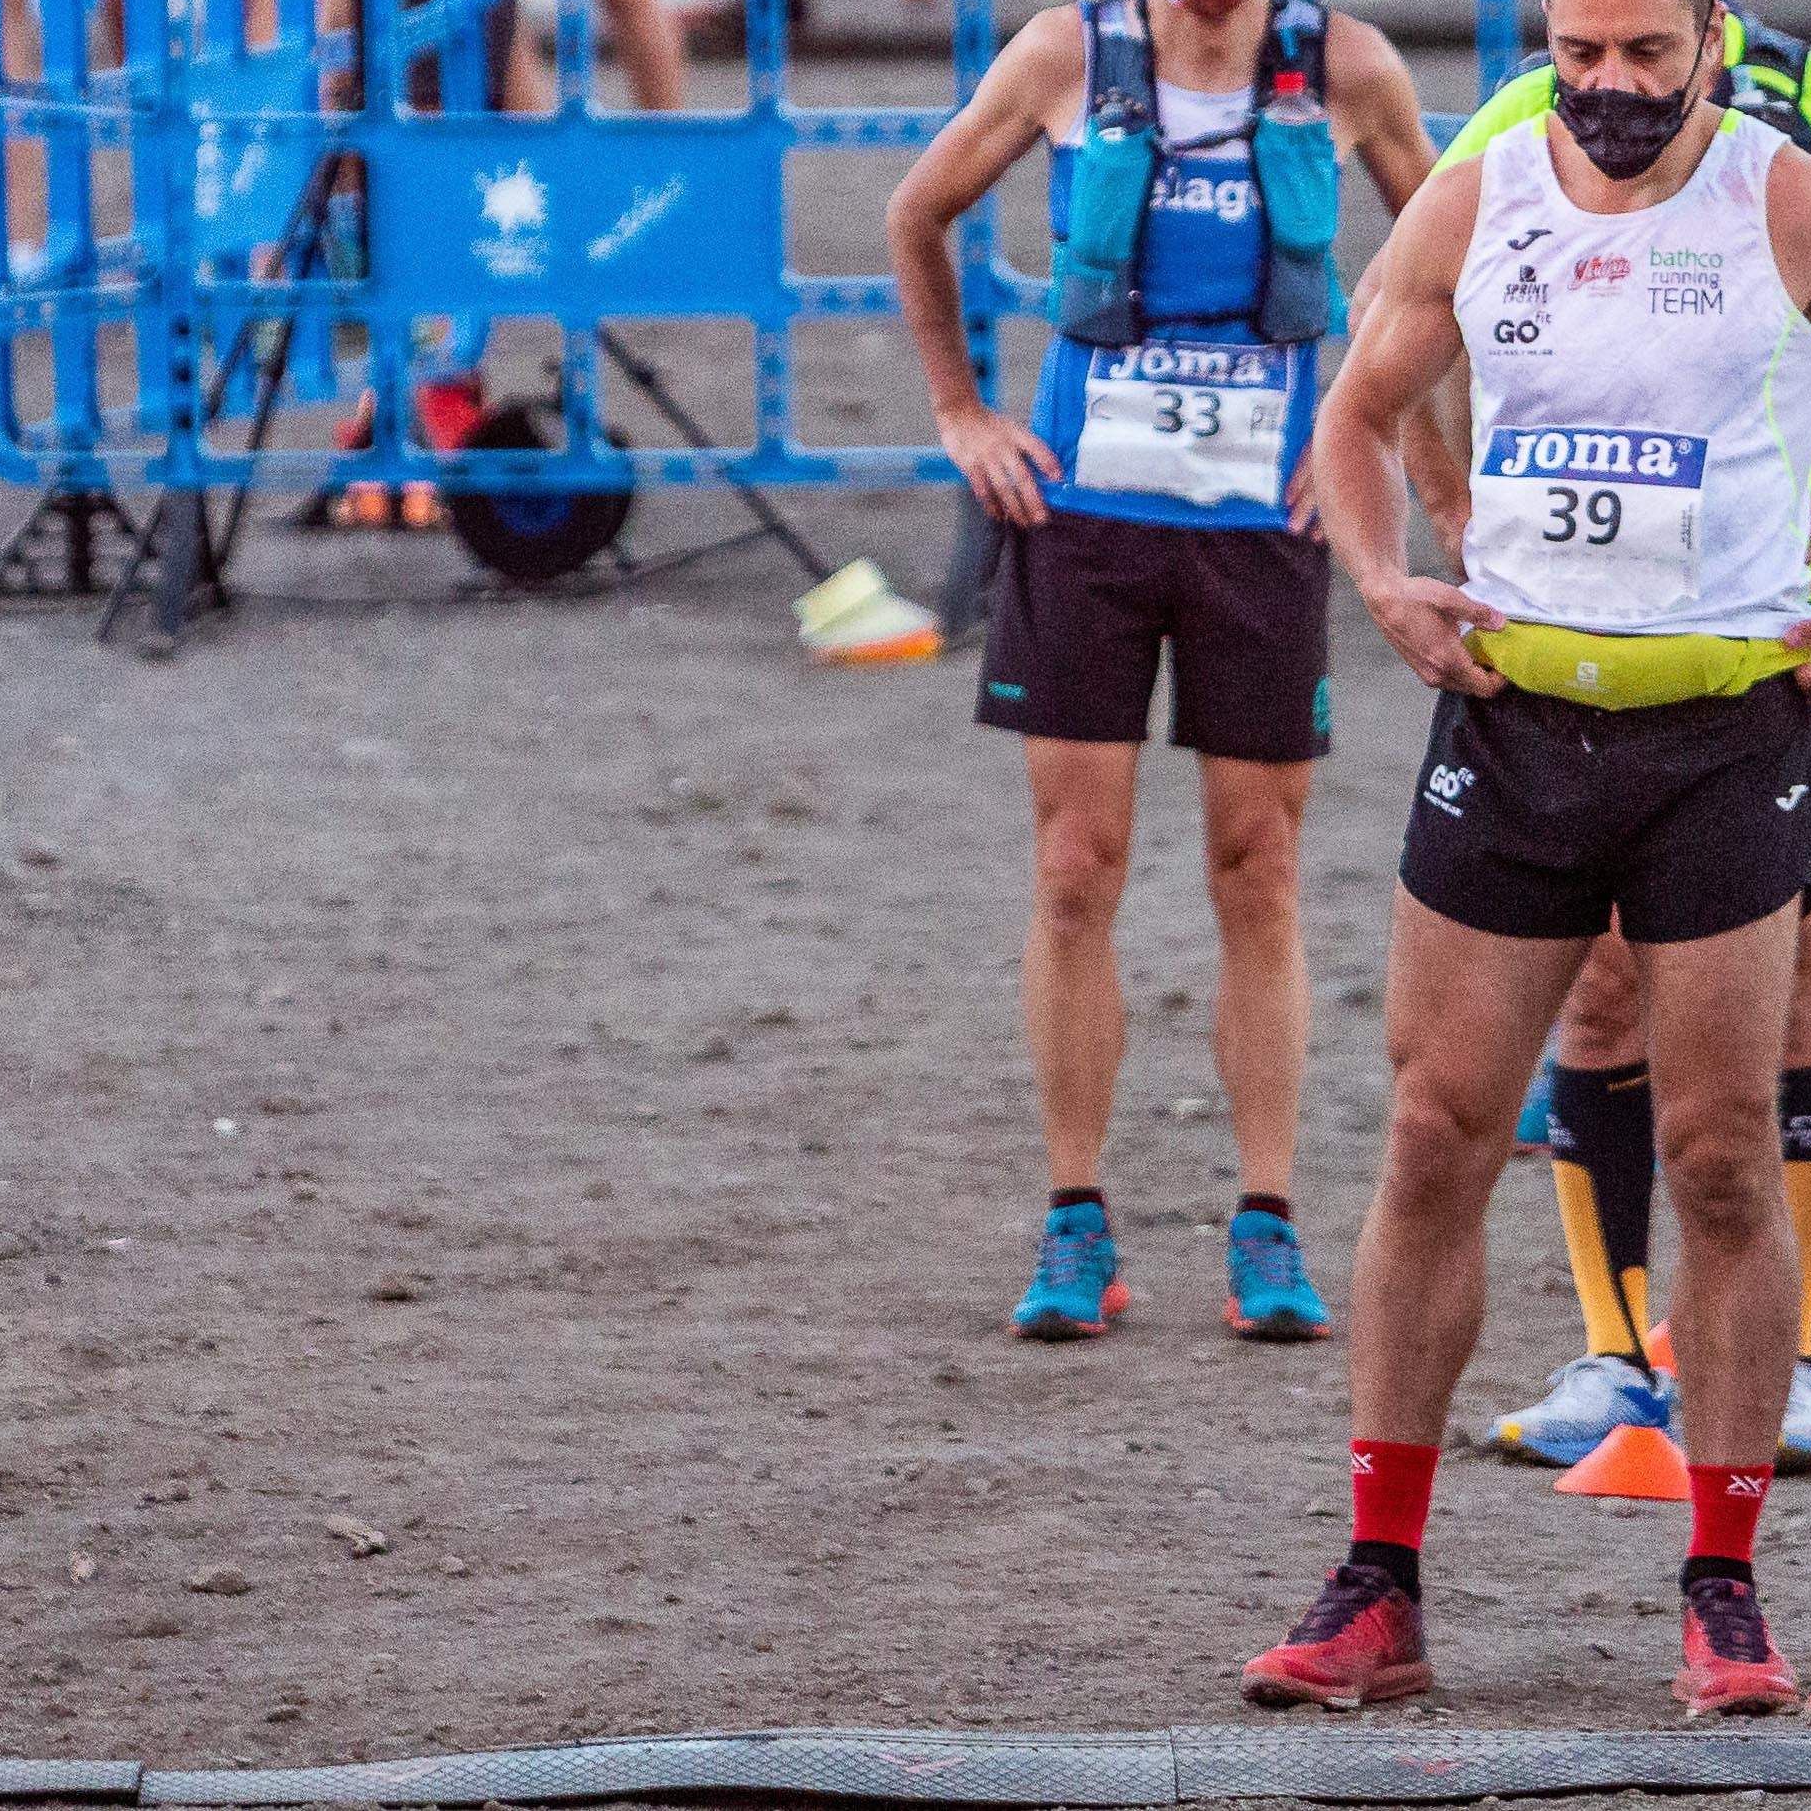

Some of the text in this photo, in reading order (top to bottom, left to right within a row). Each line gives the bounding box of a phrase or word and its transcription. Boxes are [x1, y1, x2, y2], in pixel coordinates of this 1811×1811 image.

[1649, 245, 1723, 269] bathco
[1650, 270, 1721, 289] running
[1647, 287, 1723, 315] TEAM
[1152, 388, 1221, 439] 33
[1542, 485, 1622, 546] 39
